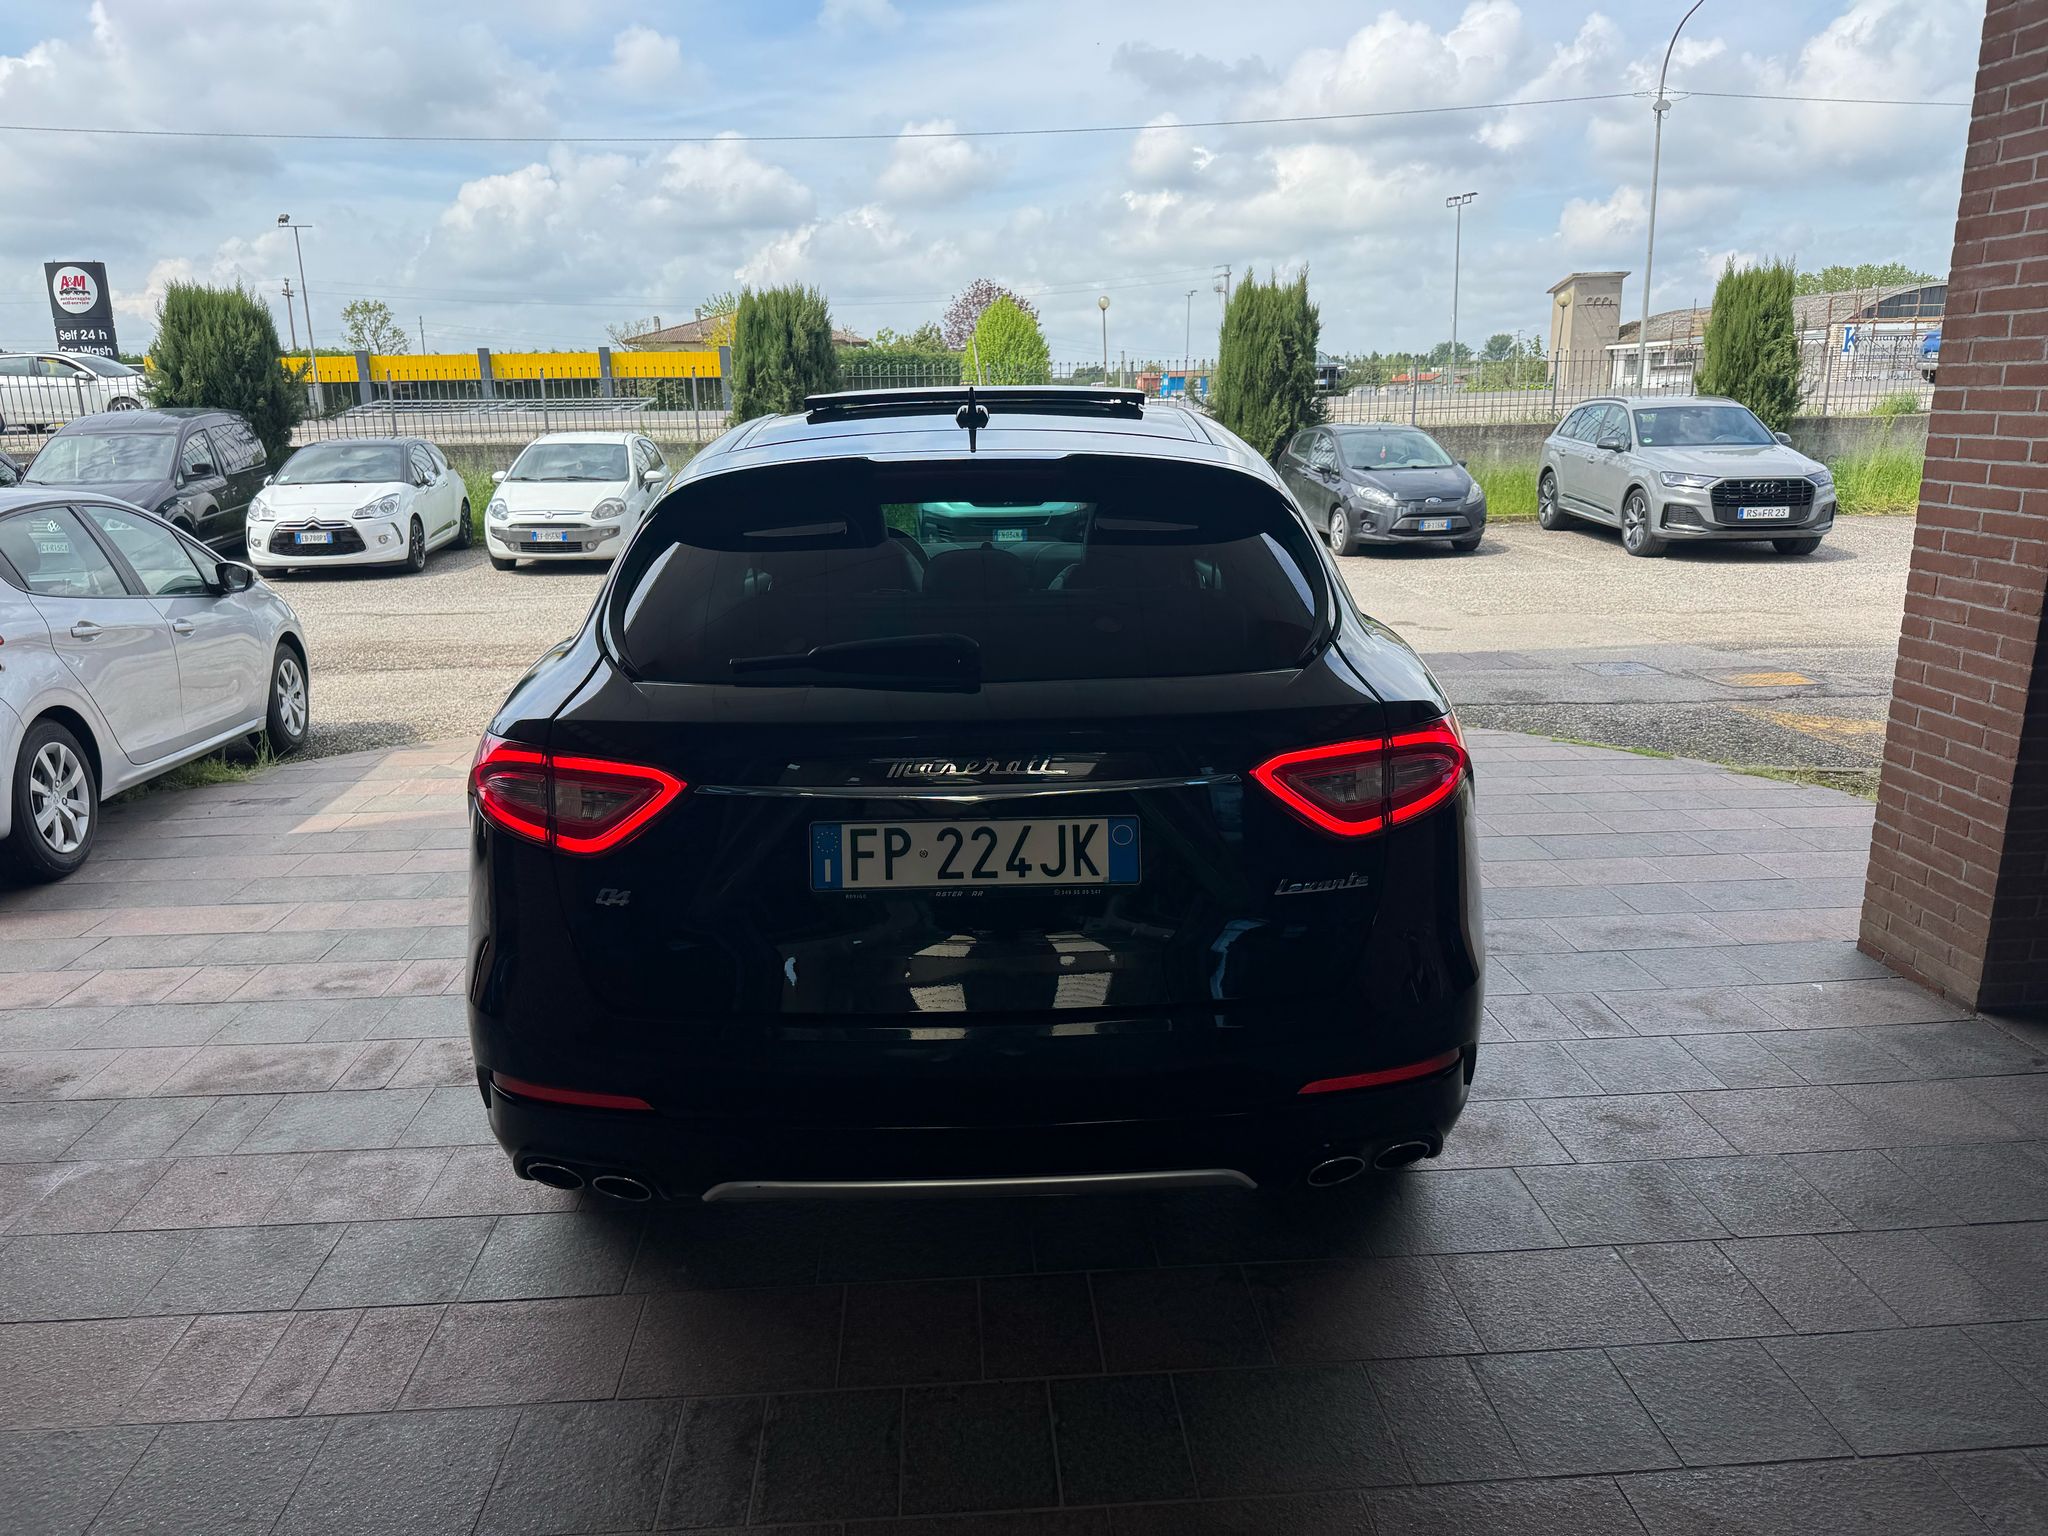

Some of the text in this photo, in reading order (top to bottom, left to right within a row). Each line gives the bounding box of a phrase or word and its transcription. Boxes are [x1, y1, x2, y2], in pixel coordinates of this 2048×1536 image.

[60, 275, 86, 290] A&M
[60, 329, 107, 340] Self 24 h
[80, 345, 113, 356] Wash
[1746, 508, 1786, 517] RS FR 23
[886, 757, 1070, 779] Maserati
[849, 827, 912, 882] FP
[936, 823, 1101, 880] 224JK
[1274, 871, 1369, 896] Levante
[595, 887, 632, 906] Q4
